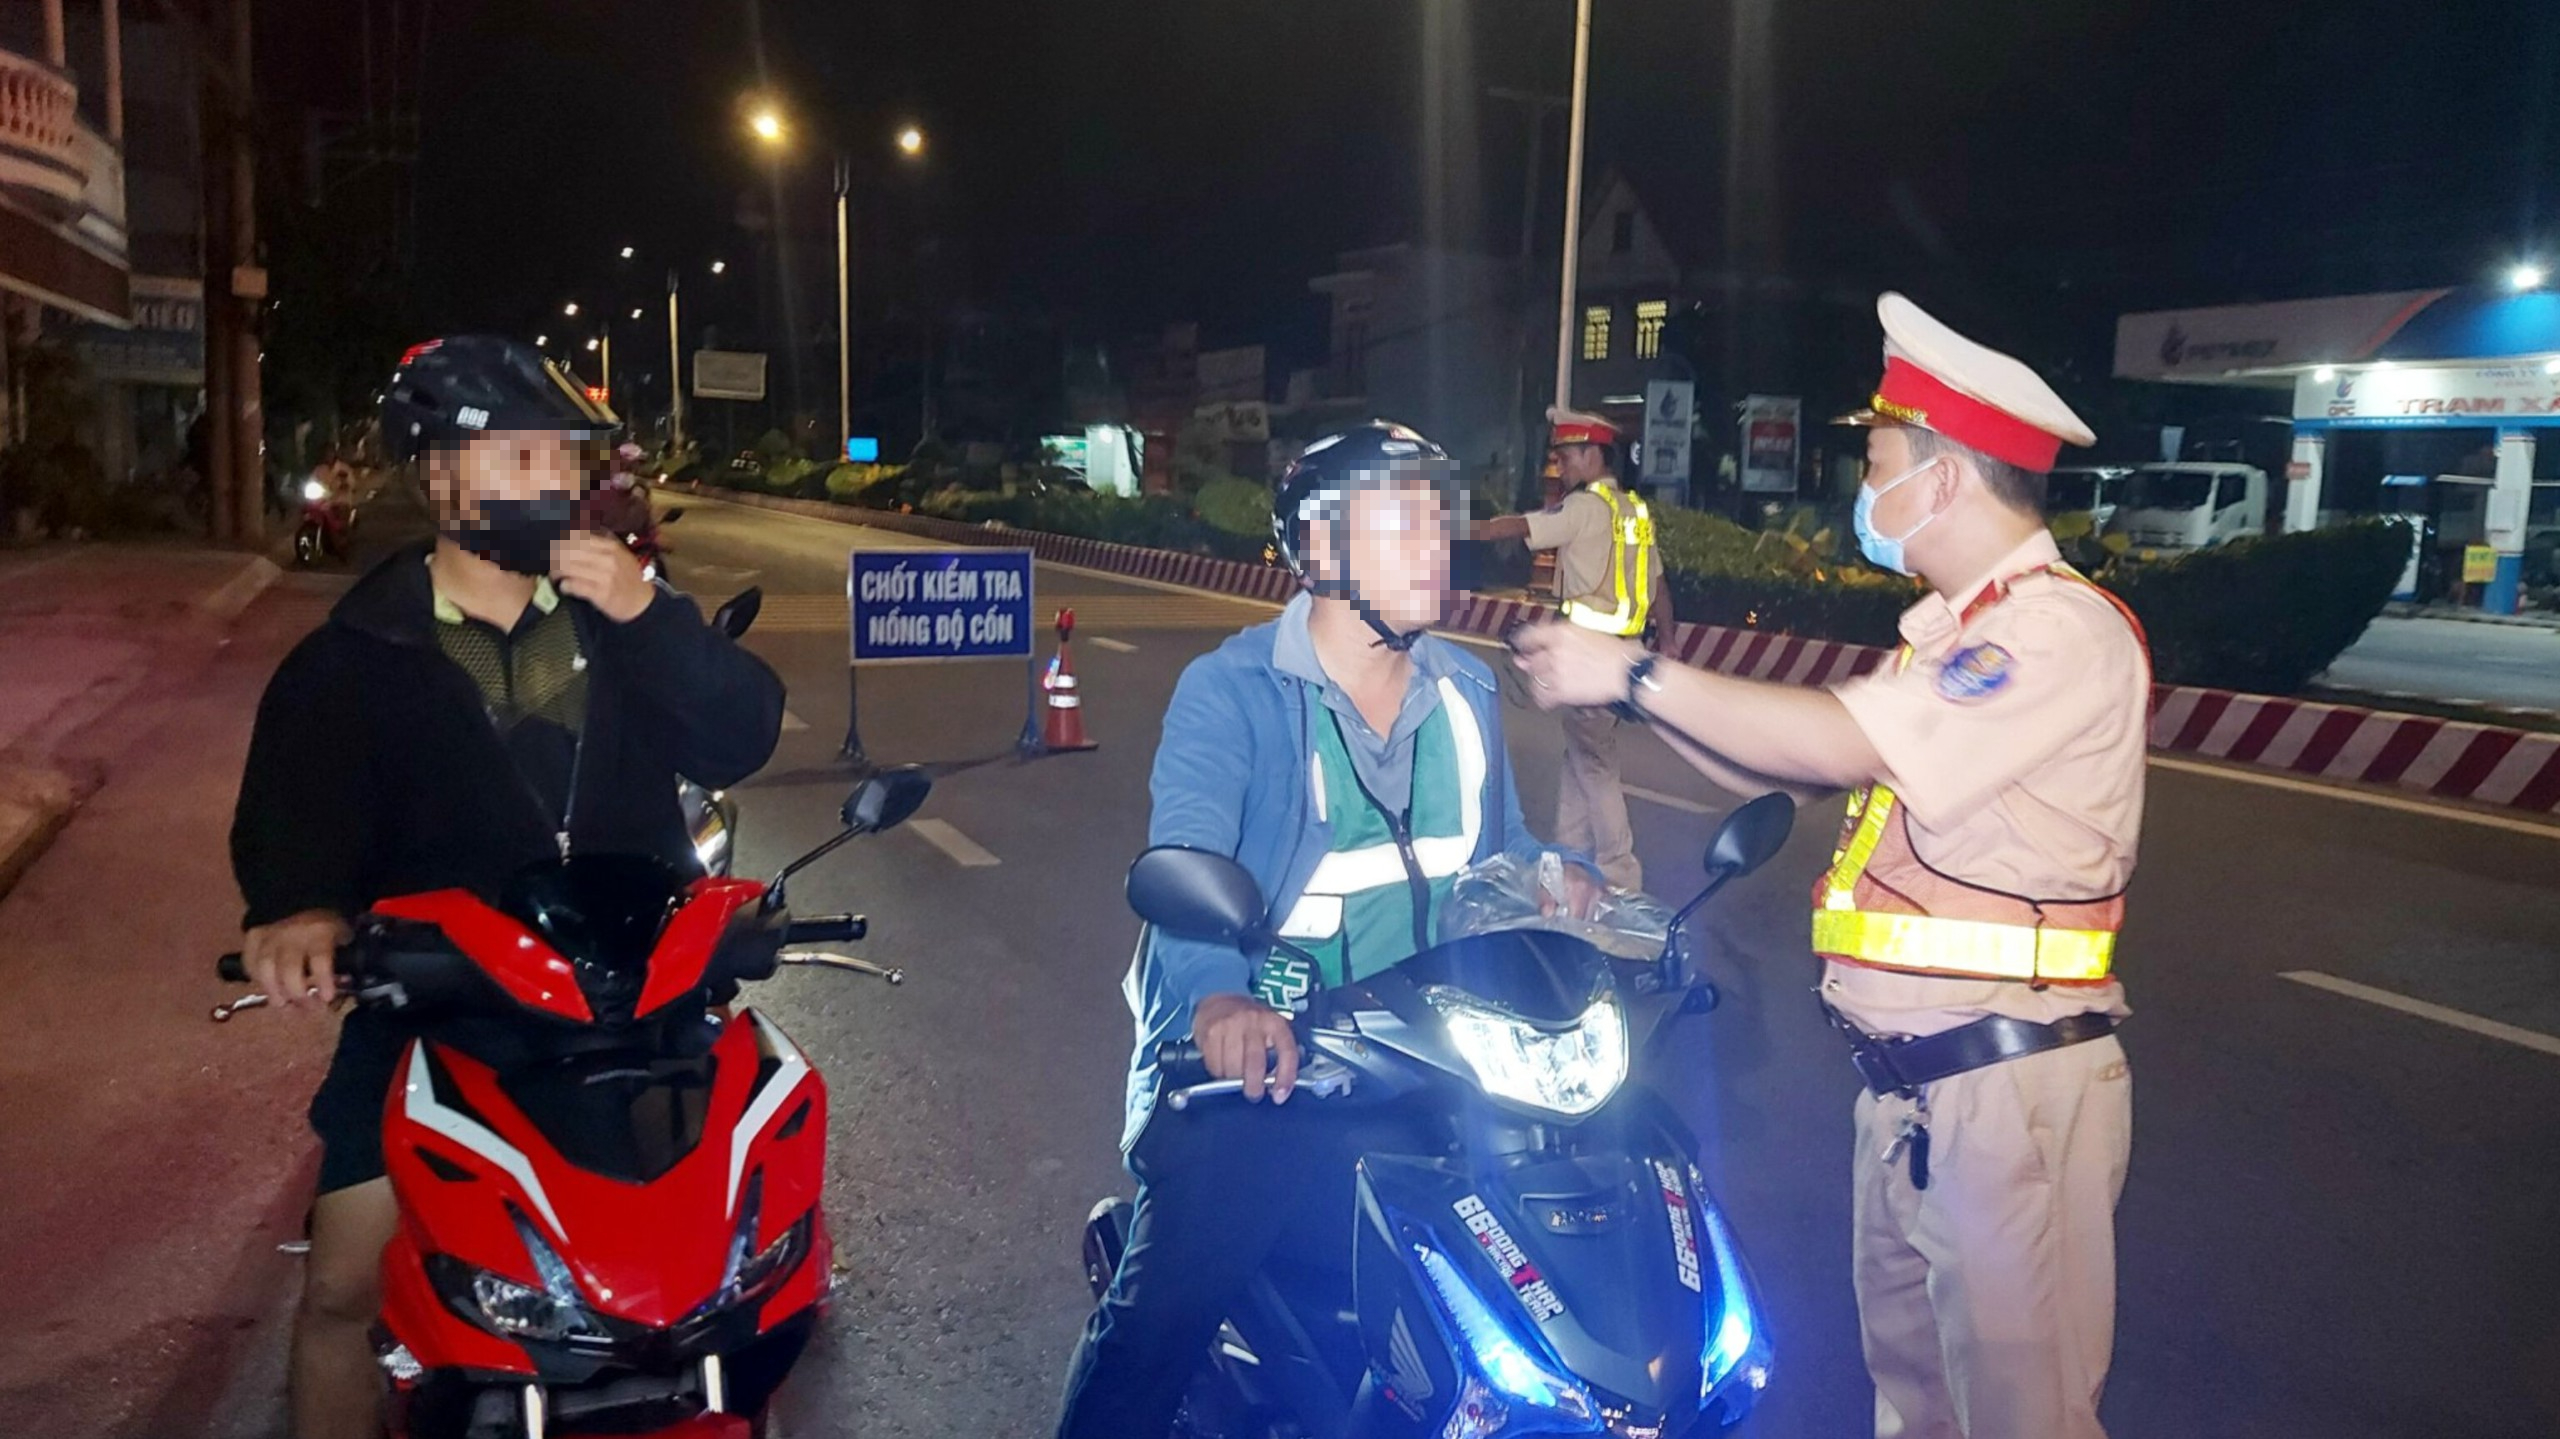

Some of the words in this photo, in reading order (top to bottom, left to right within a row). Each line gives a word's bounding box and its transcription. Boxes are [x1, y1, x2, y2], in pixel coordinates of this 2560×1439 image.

[860, 559, 919, 603] CHỐT
[922, 557, 979, 603] KIỂM
[983, 570, 1023, 602] TRA
[868, 605, 931, 647] NỒNG
[935, 608, 966, 652] ĐỘ
[969, 604, 1014, 646] CỒN
[1453, 1193, 1499, 1236] 66
